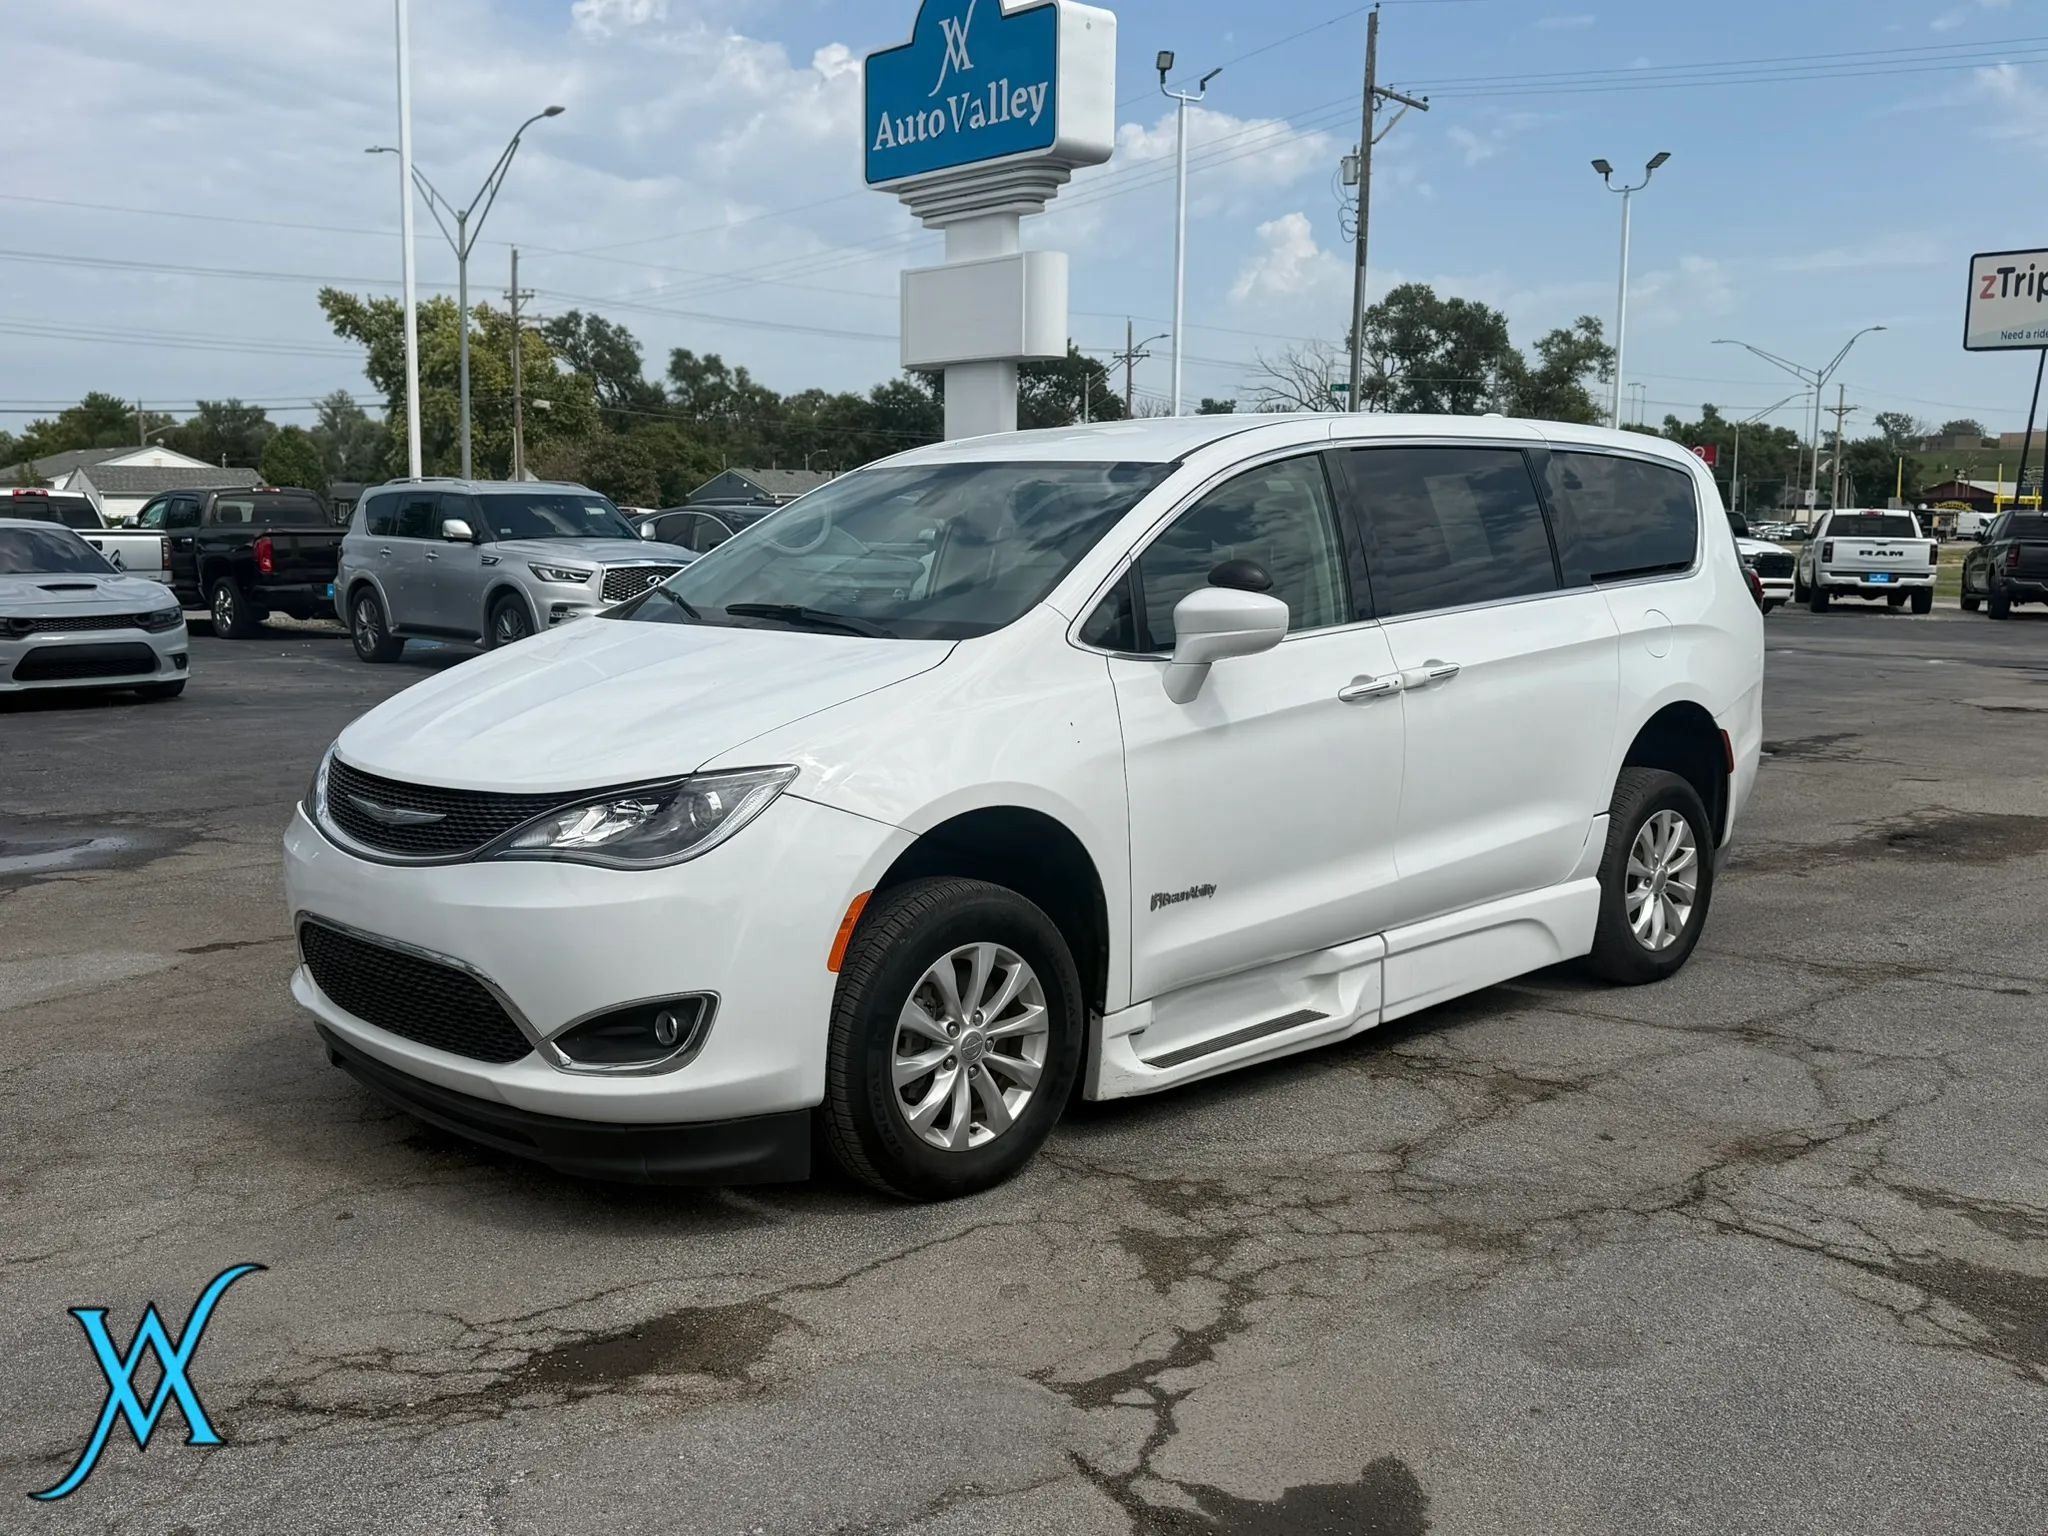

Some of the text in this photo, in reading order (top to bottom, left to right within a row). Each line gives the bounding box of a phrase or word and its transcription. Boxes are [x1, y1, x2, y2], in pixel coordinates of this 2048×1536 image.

[1979, 263, 2048, 303] zTrip
[2000, 329, 2024, 340] Need
[2025, 331, 2031, 339] a
